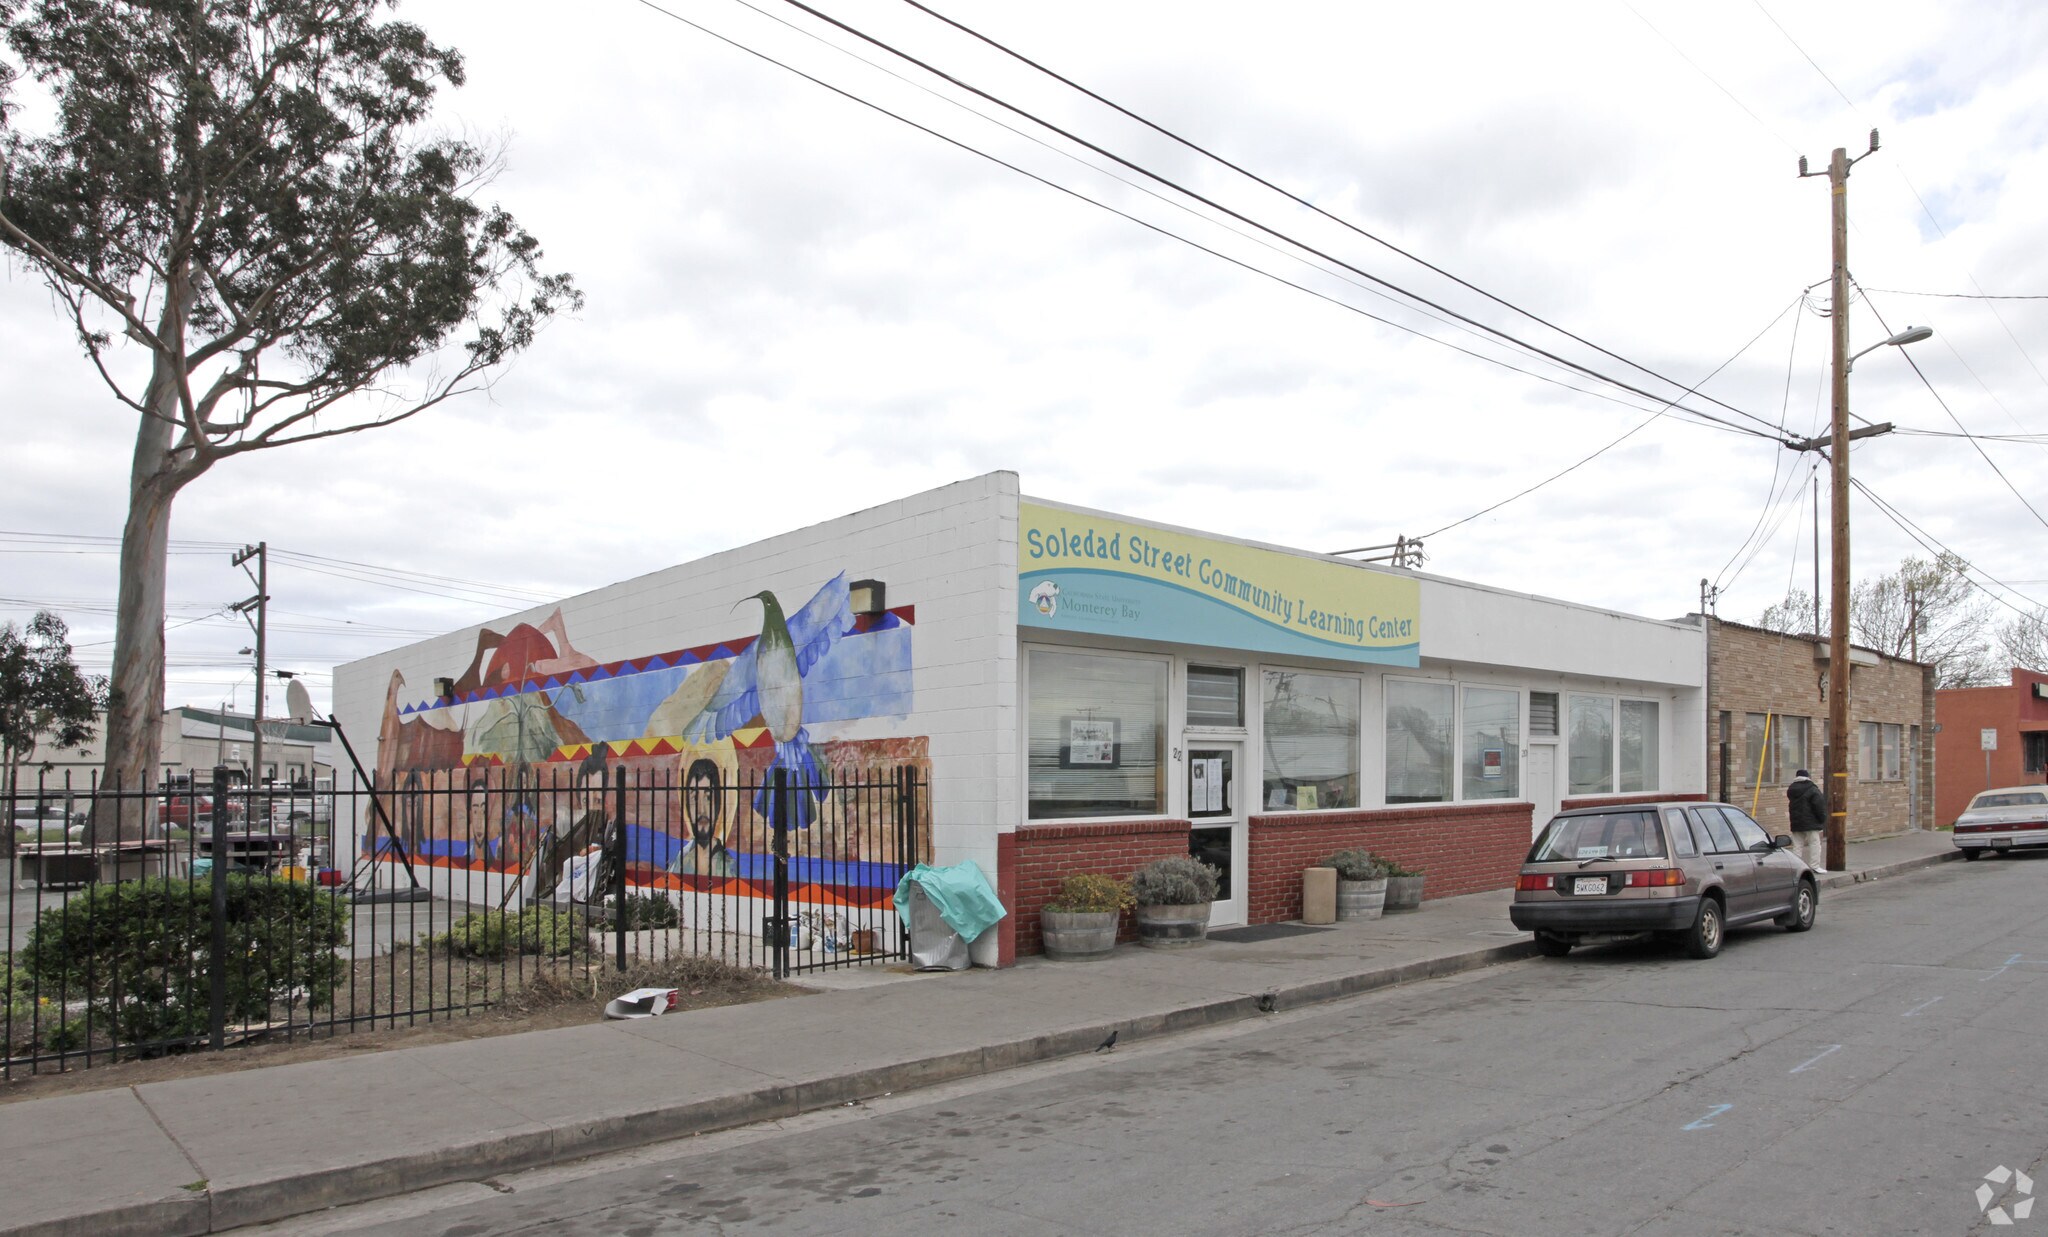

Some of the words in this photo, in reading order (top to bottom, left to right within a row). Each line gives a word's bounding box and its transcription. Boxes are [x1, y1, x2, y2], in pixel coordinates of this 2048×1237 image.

[1027, 527, 1121, 561] Soledad
[1129, 535, 1192, 578] Street
[1198, 558, 1293, 624] Community
[1297, 599, 1363, 643] Learning
[1368, 615, 1412, 639] Center
[1061, 597, 1118, 618] Monterey
[1121, 604, 1141, 621] Bay
[1173, 747, 1183, 762] 22
